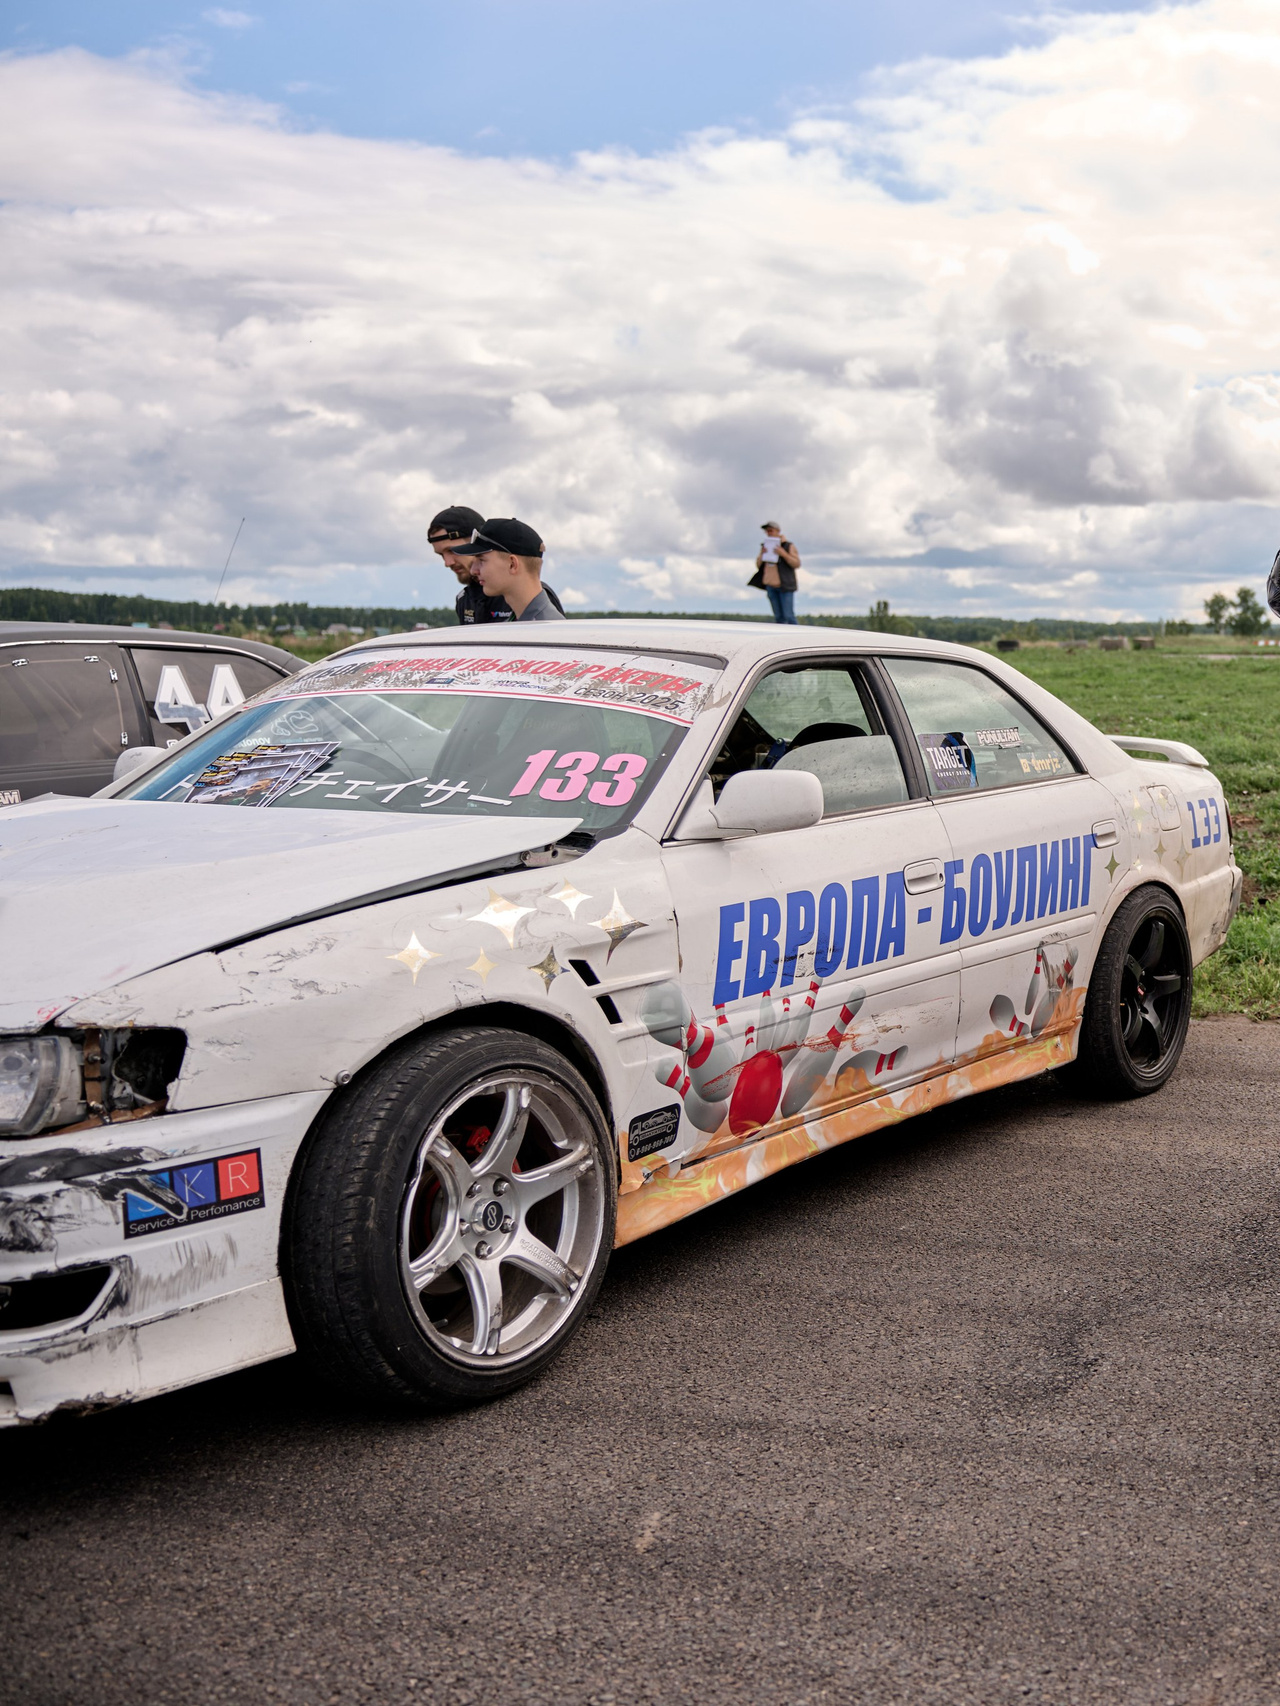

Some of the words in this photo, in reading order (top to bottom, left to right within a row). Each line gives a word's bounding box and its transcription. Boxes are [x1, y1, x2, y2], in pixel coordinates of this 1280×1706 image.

[574, 664, 703, 694] РАКЕТЫ
[627, 692, 686, 711] 2025
[927, 746, 969, 770] TARGET
[509, 750, 648, 807] 133
[1186, 797, 1221, 849] 133
[713, 870, 905, 1006] ЕВРОПА
[940, 832, 1099, 945] БОУЛИНГ
[129, 1215, 175, 1234] Service
[190, 1196, 261, 1220] Perfomance
